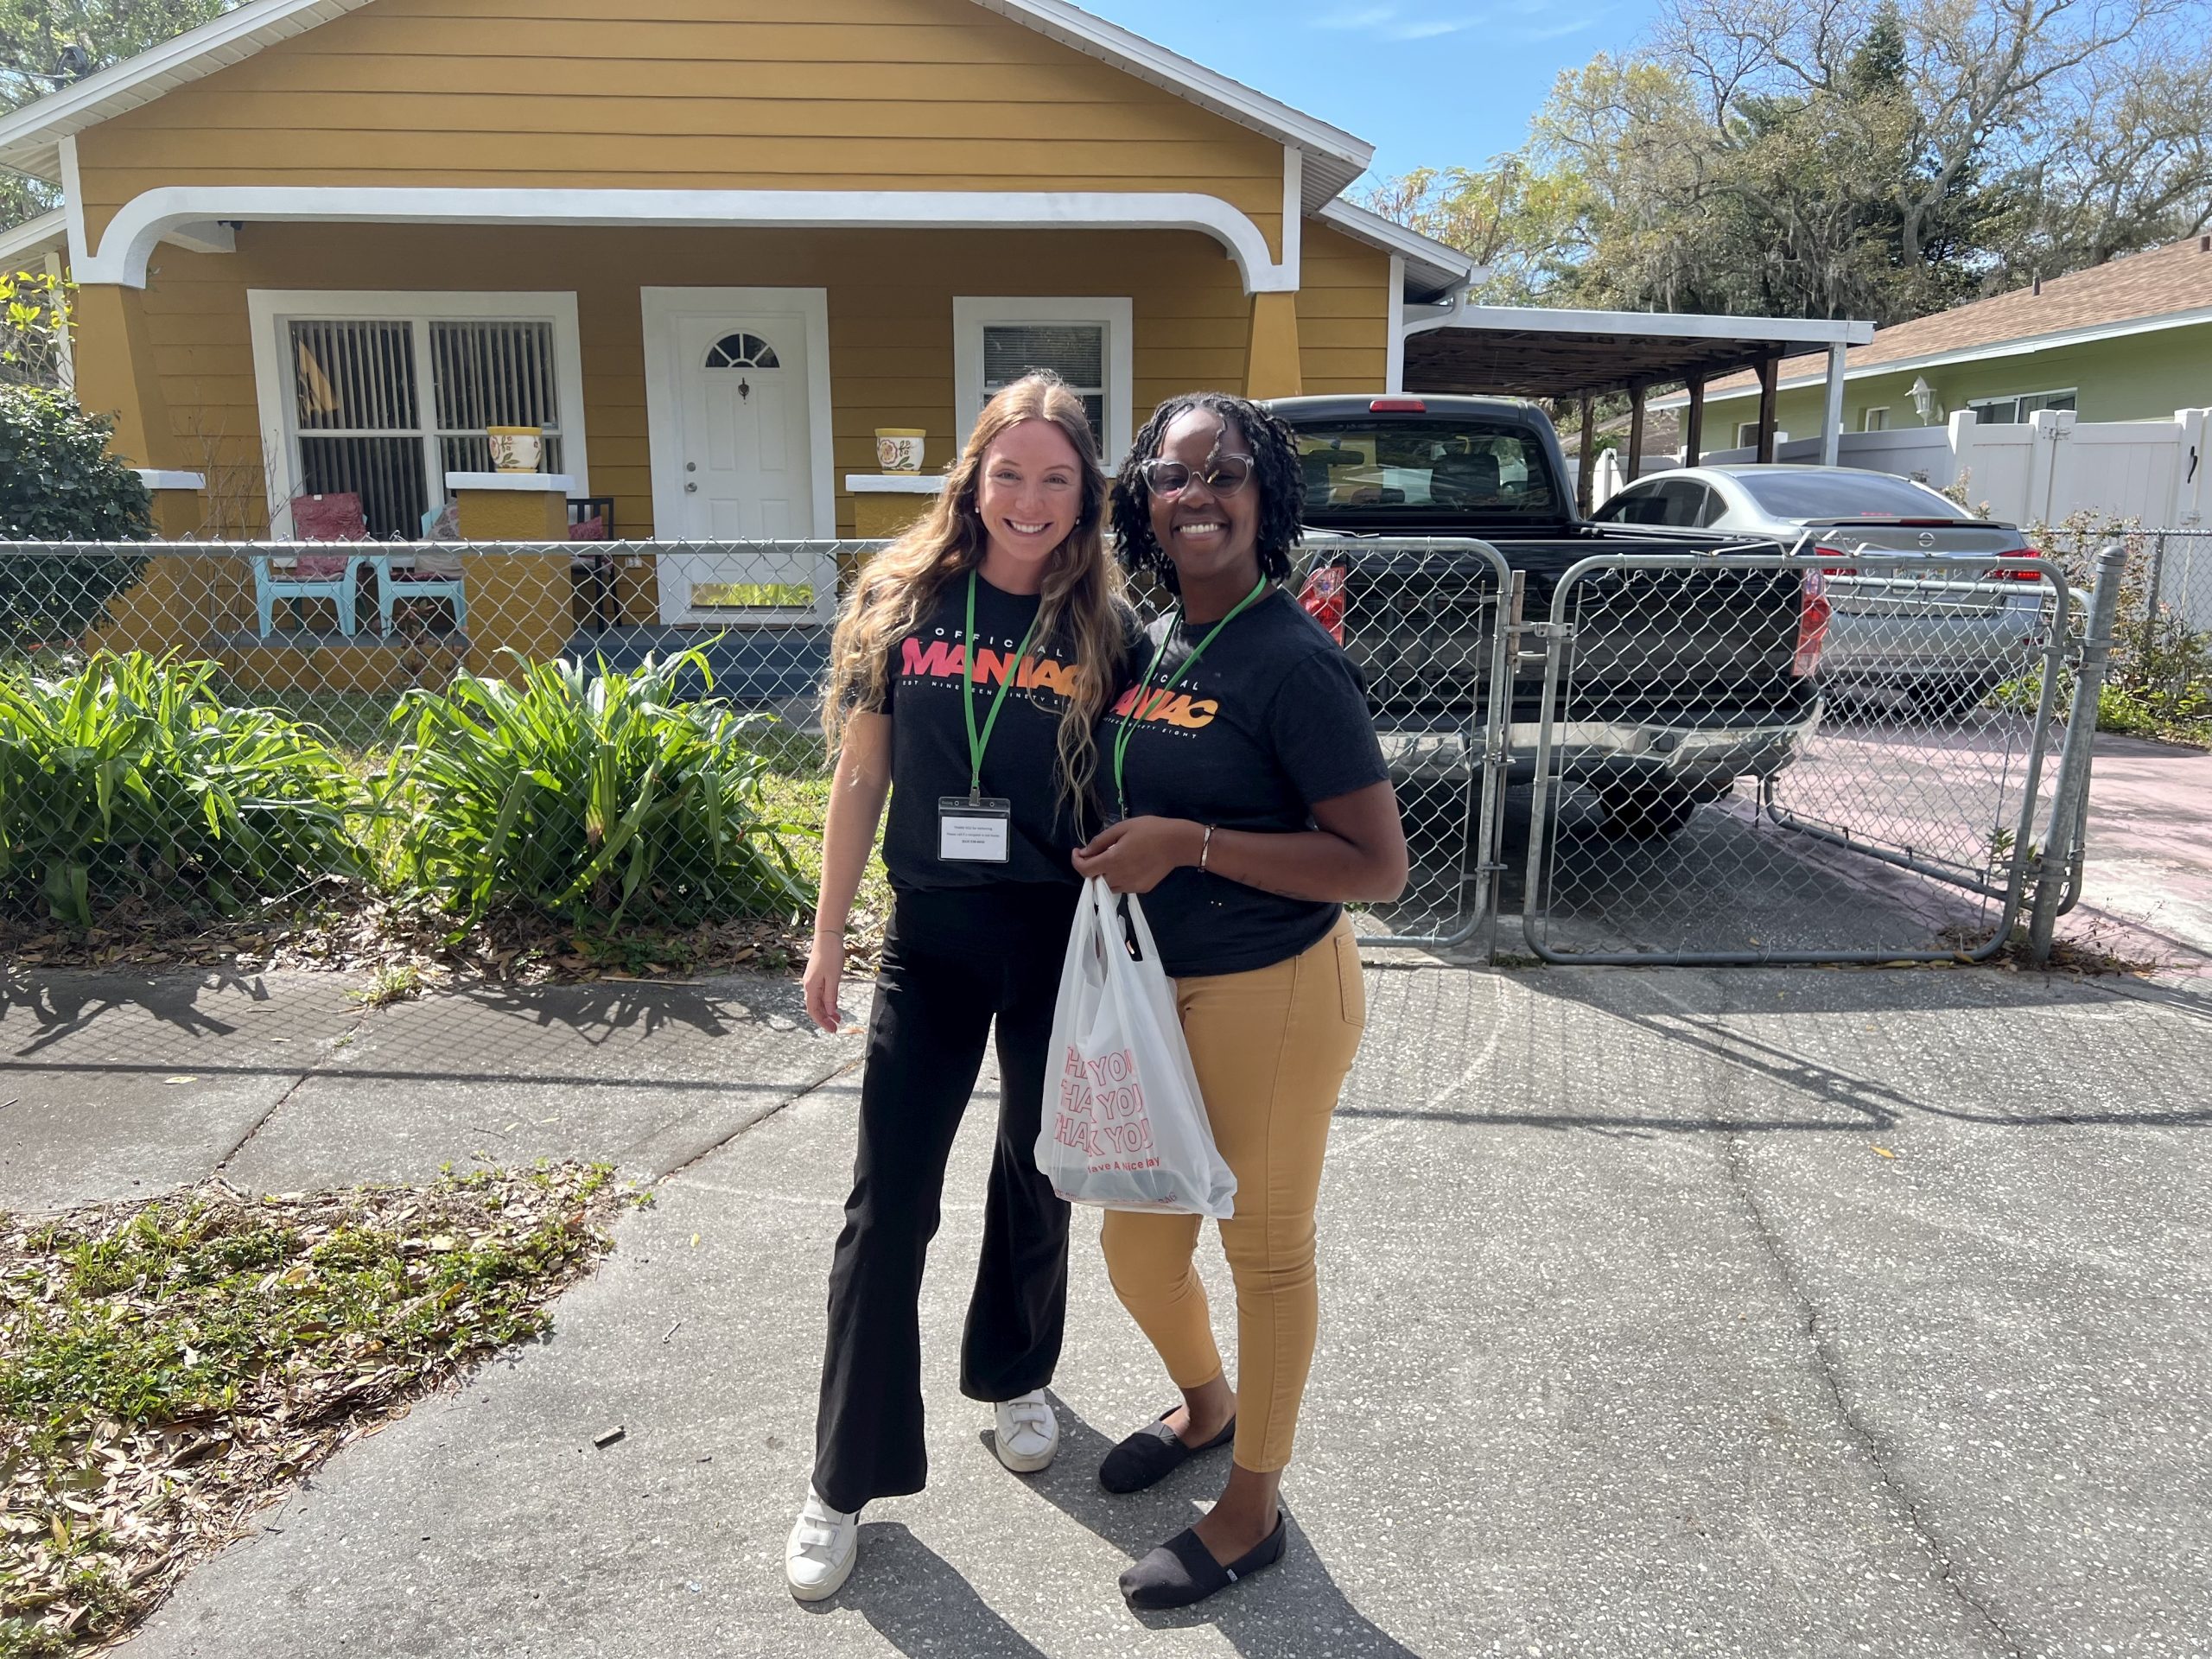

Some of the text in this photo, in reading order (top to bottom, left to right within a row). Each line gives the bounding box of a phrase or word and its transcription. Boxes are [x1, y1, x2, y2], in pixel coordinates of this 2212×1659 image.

[934, 627, 1063, 658] OFFICAL
[931, 681, 993, 696] NINEEEN
[1008, 692, 1046, 702] INETY
[1109, 683, 1218, 728] ANIAC
[1161, 728, 1198, 740] EIGHT
[1088, 1049, 1132, 1087] YO
[1113, 1161, 1121, 1171] A
[1122, 1160, 1144, 1172] Nice
